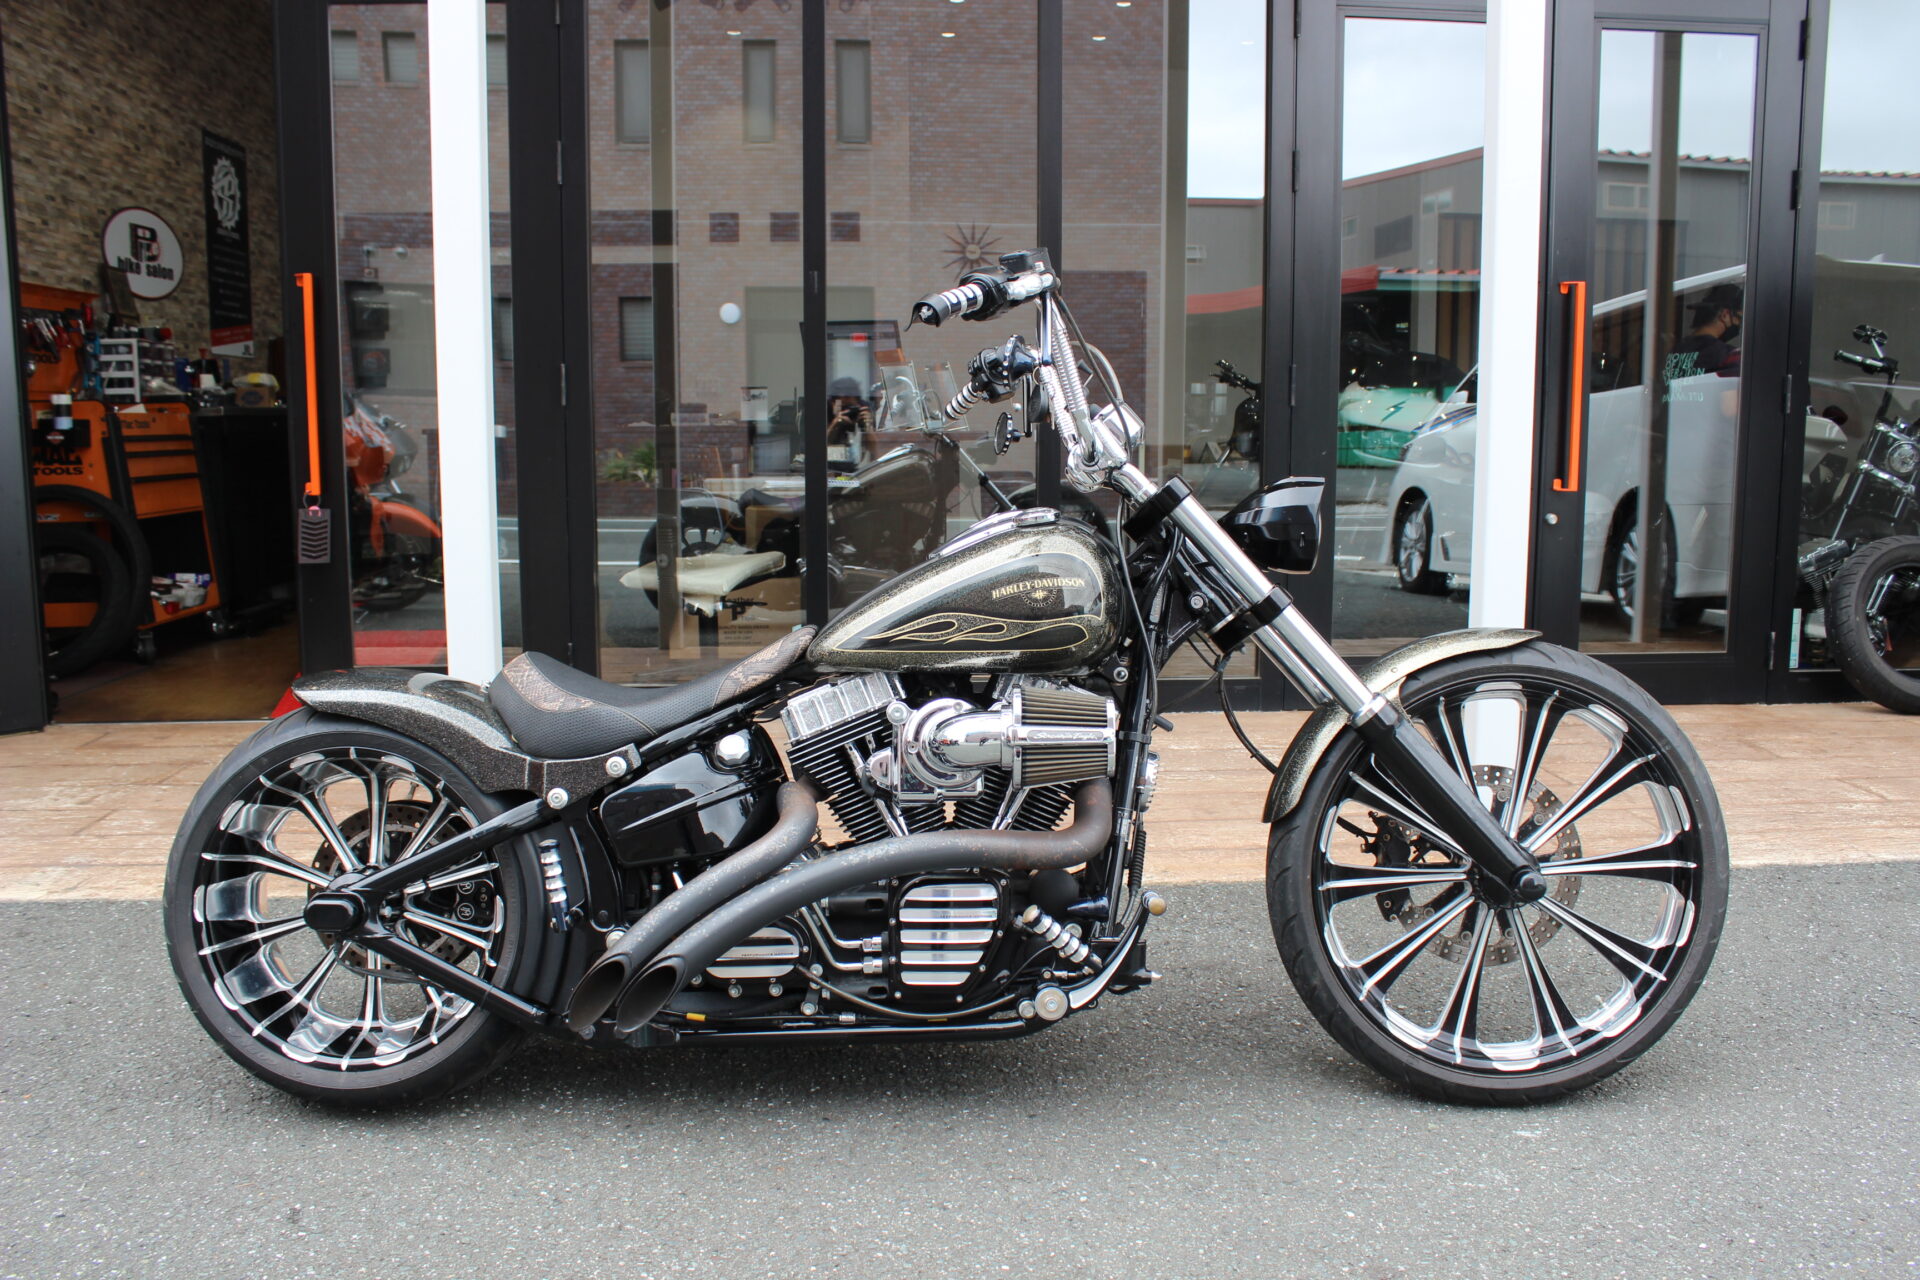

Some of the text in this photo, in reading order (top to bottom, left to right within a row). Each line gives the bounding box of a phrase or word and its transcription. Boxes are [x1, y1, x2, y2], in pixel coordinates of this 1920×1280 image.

[117, 255, 174, 281] bike salon
[32, 467, 84, 476] TOOLS
[991, 577, 1086, 600] HARLEY-DAVIDSON
